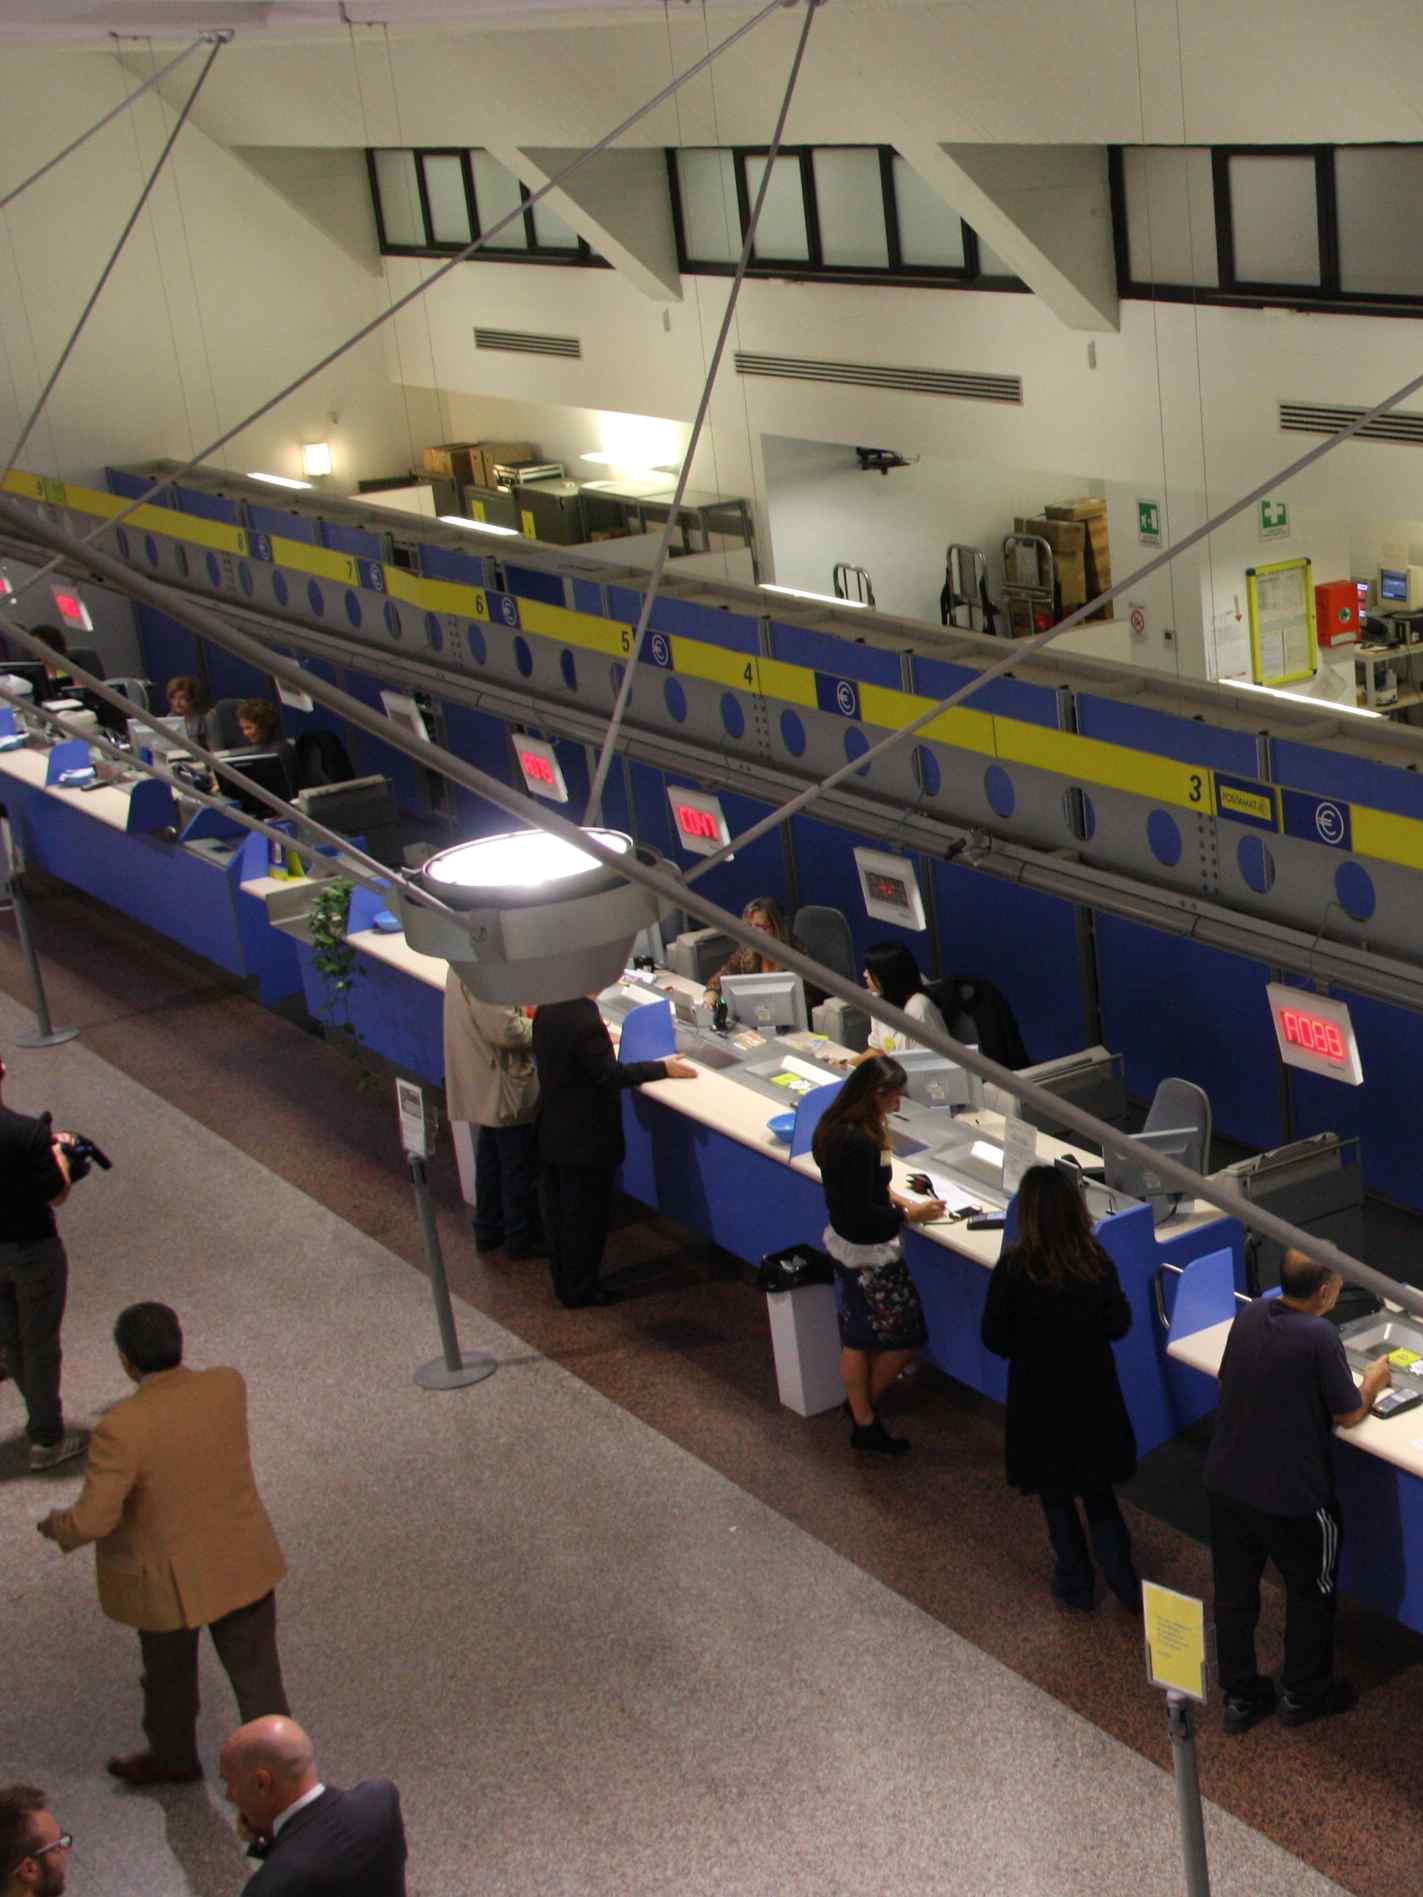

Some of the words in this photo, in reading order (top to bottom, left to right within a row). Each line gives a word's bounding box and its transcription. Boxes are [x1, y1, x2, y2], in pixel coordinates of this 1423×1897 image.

[475, 594, 485, 614] 6
[621, 629, 631, 652] 5
[743, 662, 753, 684] 4
[1189, 774, 1203, 802] 3
[1283, 1010, 1345, 1057] A088
